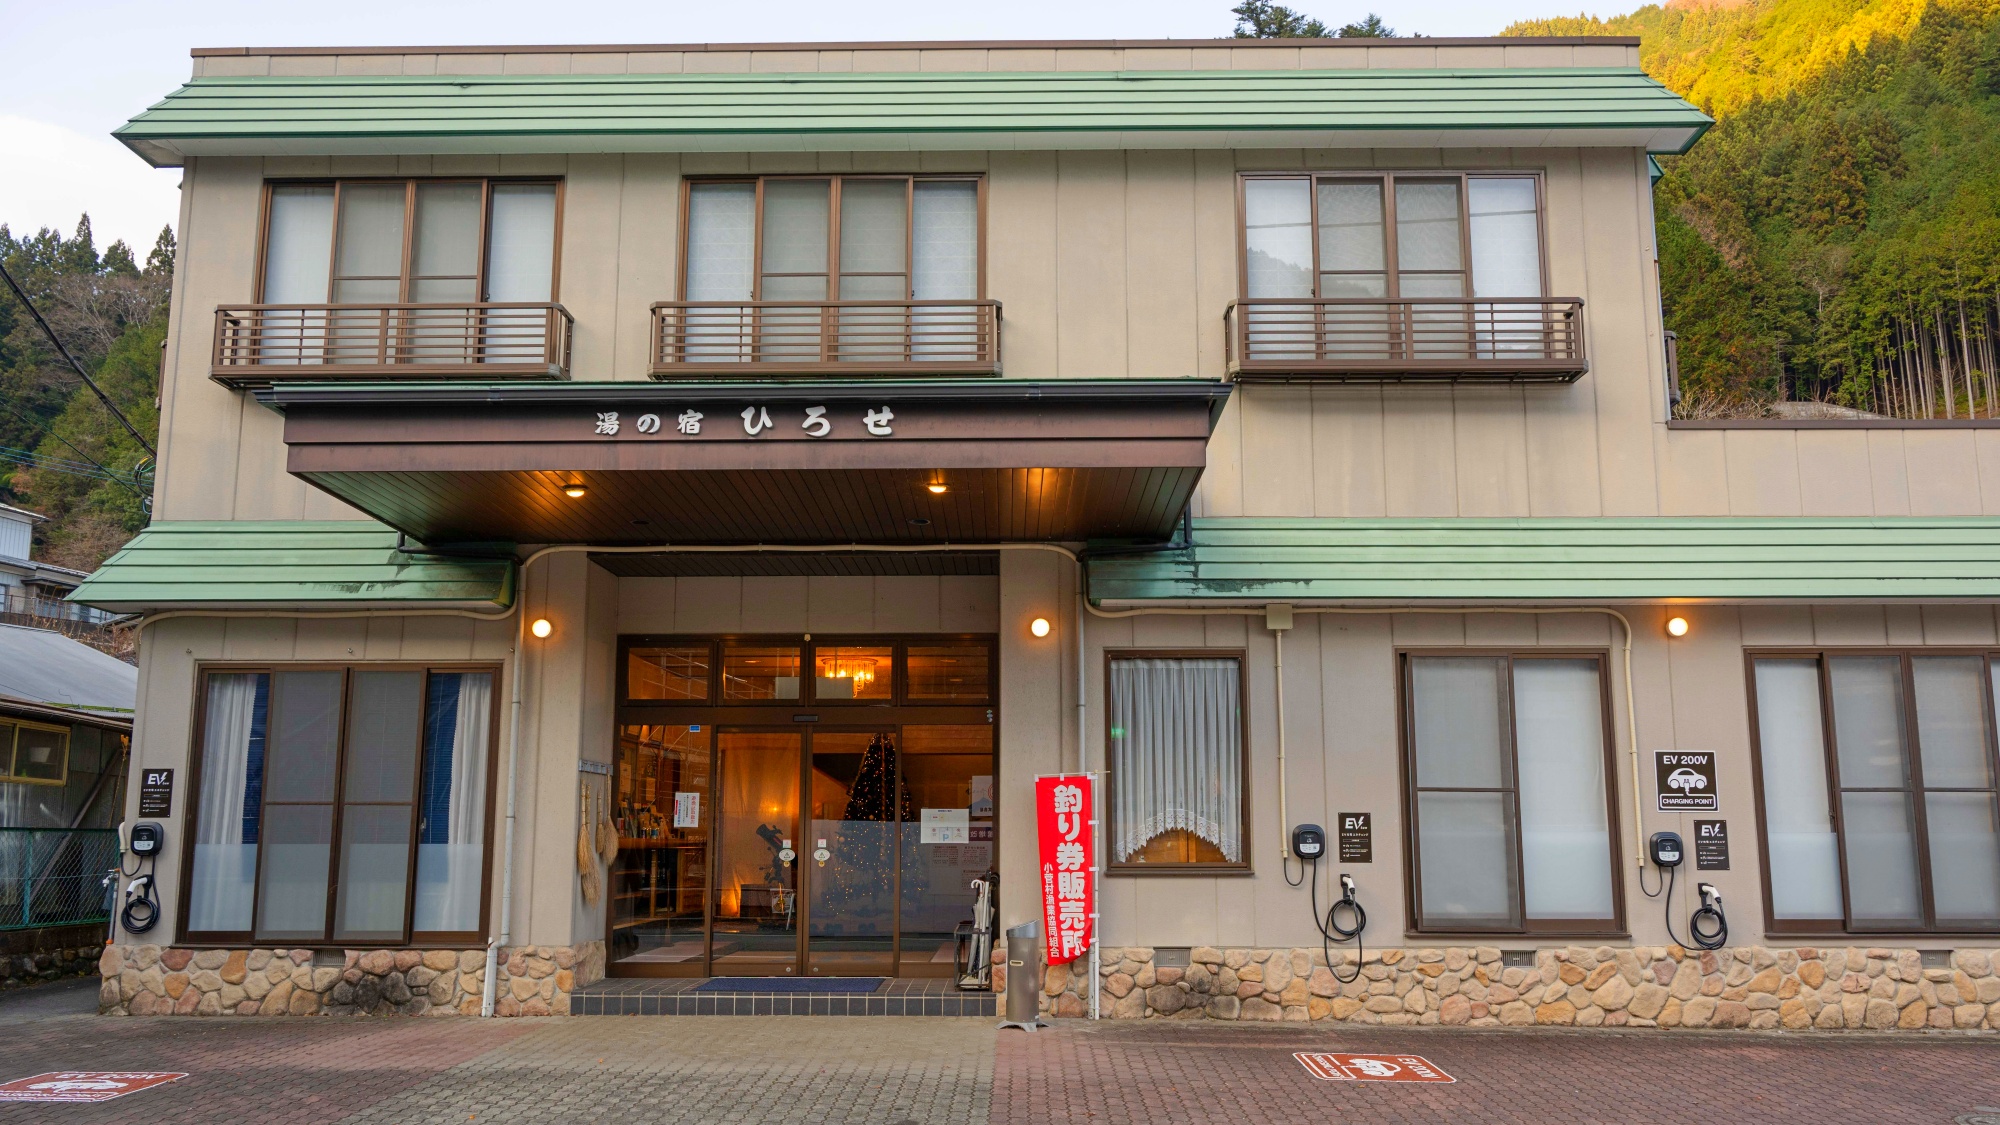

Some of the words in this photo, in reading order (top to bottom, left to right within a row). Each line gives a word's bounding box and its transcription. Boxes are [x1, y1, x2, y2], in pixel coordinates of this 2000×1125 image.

[594, 408, 704, 436] 湯の宿
[740, 405, 895, 437] ひろせ
[1663, 755, 1678, 765] EV
[1681, 755, 1708, 765] 200V
[147, 772, 168, 786] EV
[1345, 816, 1364, 830] EV
[1701, 823, 1720, 837] EV
[1053, 784, 1087, 959] 釣り券販売所
[1043, 862, 1060, 958] 小菅村漁業協同組合
